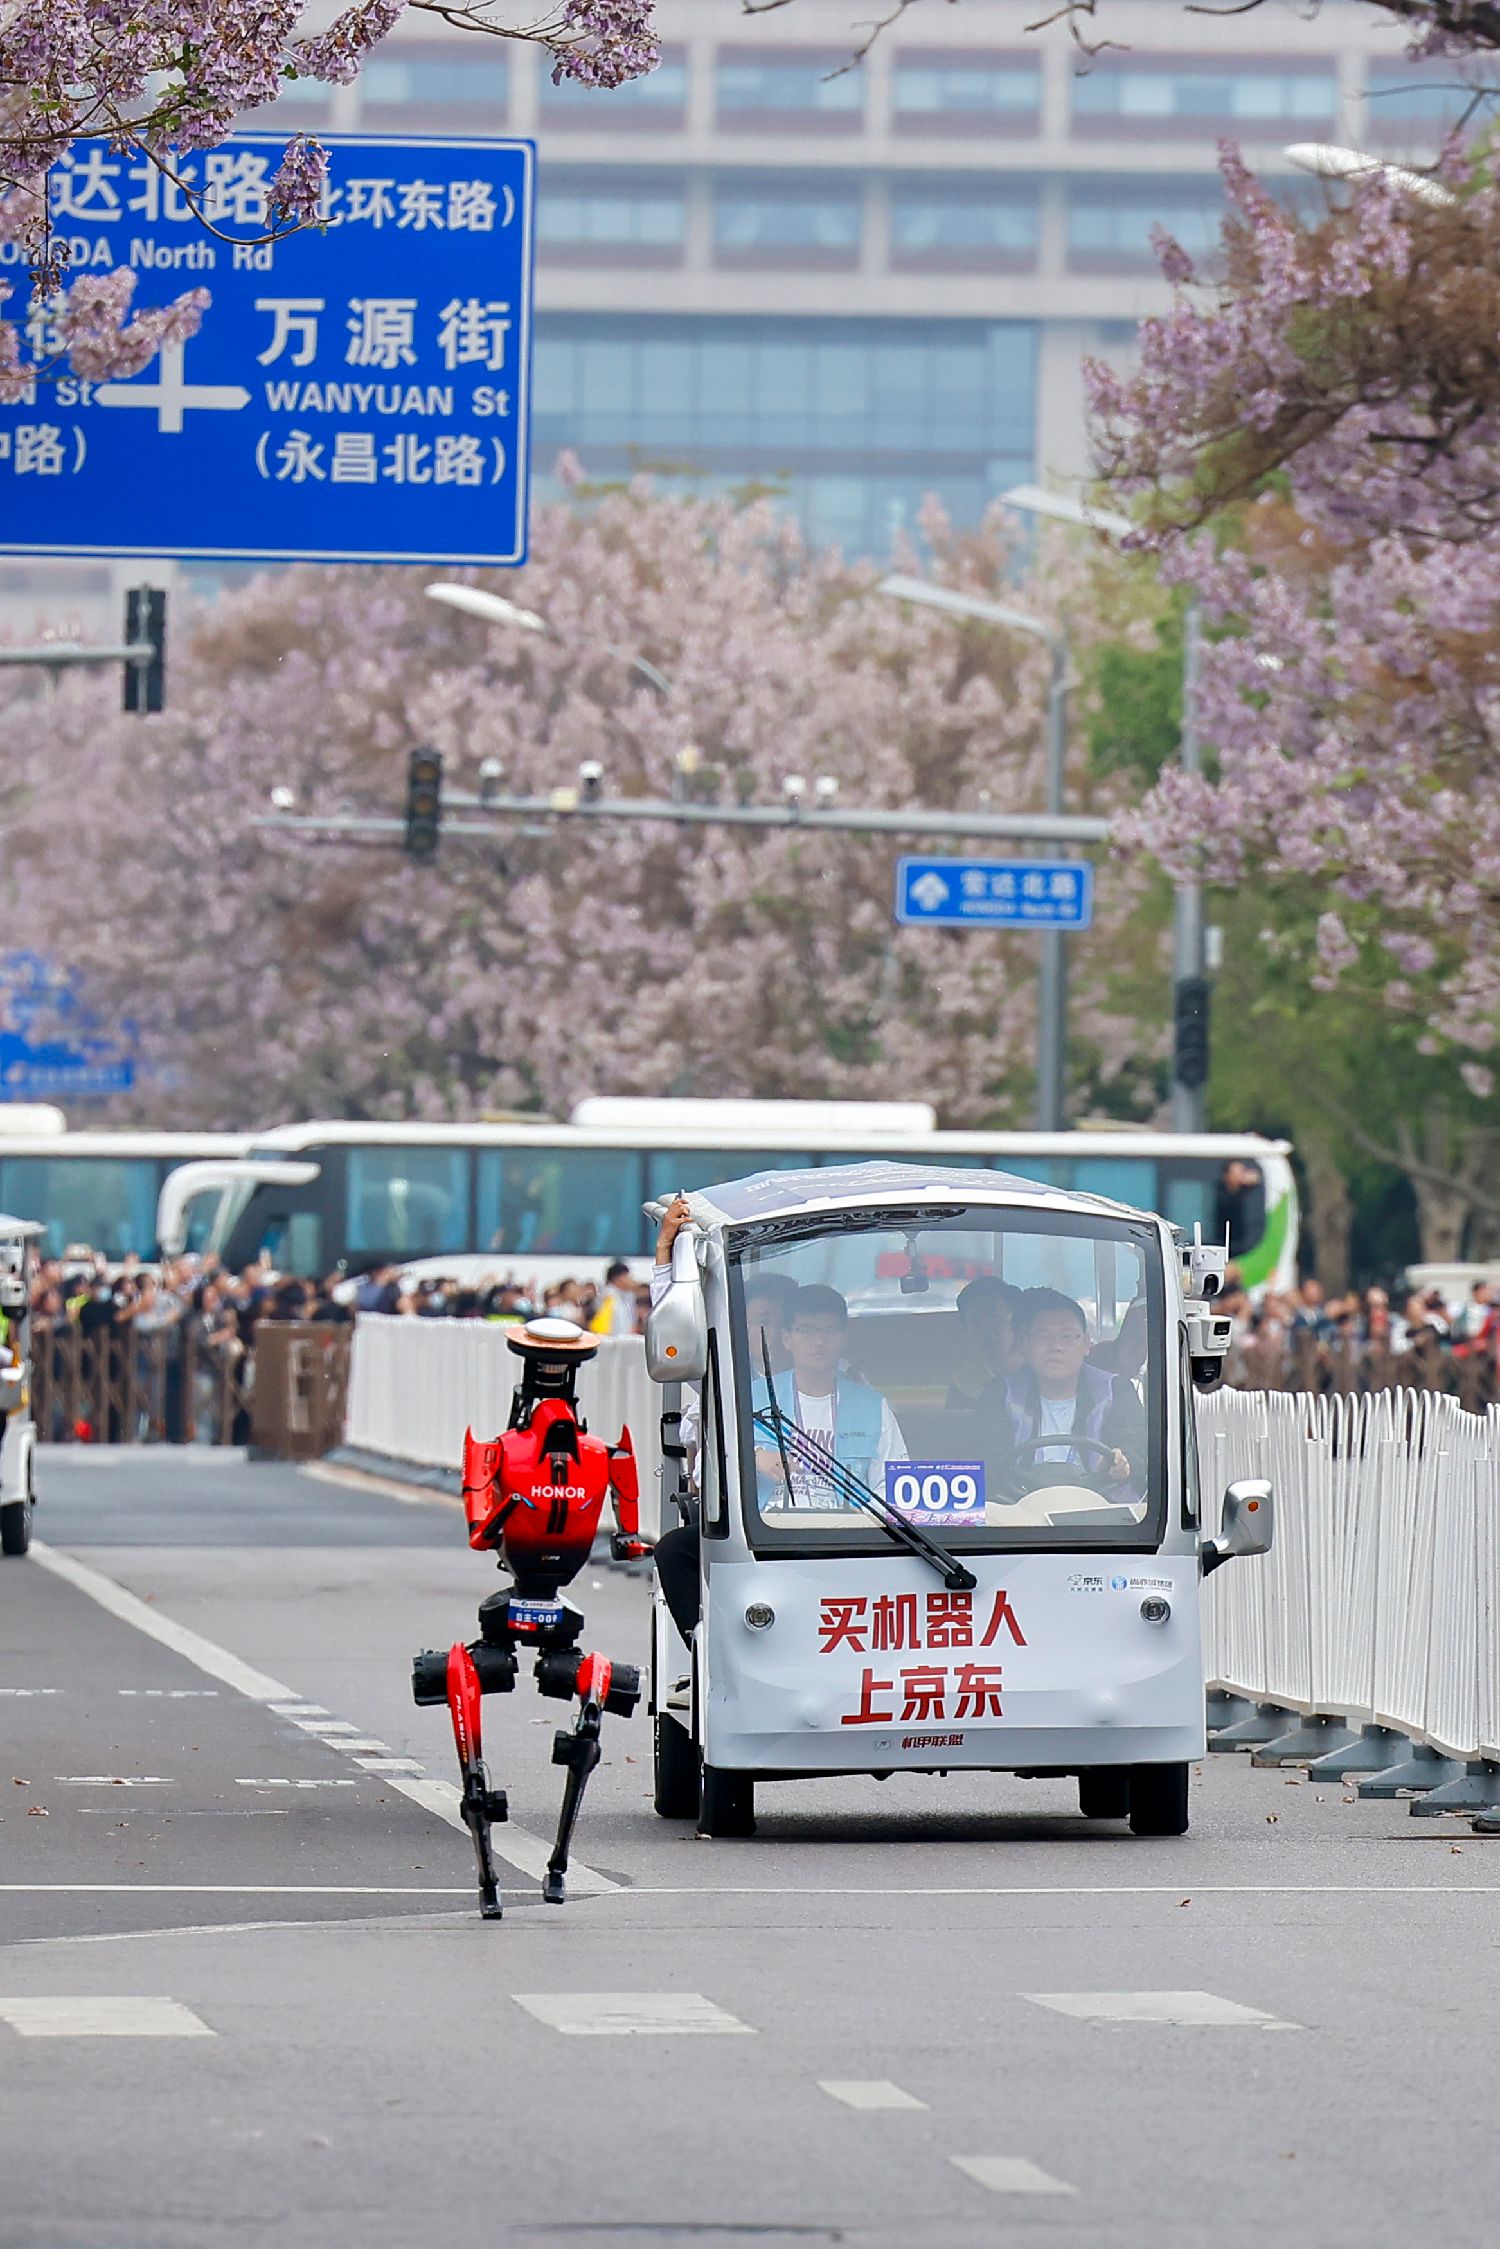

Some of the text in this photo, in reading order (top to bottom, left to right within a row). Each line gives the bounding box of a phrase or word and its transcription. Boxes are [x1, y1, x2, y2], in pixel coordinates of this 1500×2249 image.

[129, 238, 215, 269] North
[233, 243, 272, 270] Rd
[254, 297, 512, 371] 万源街
[55, 377, 94, 407] St
[264, 380, 511, 417] WANYUAN St
[254, 428, 506, 486] (永昌北路)
[530, 1484, 586, 1499] HONOR
[894, 1474, 977, 1510] 009
[818, 1590, 1028, 1653] 买机器人
[841, 1663, 1003, 1725] 上京东
